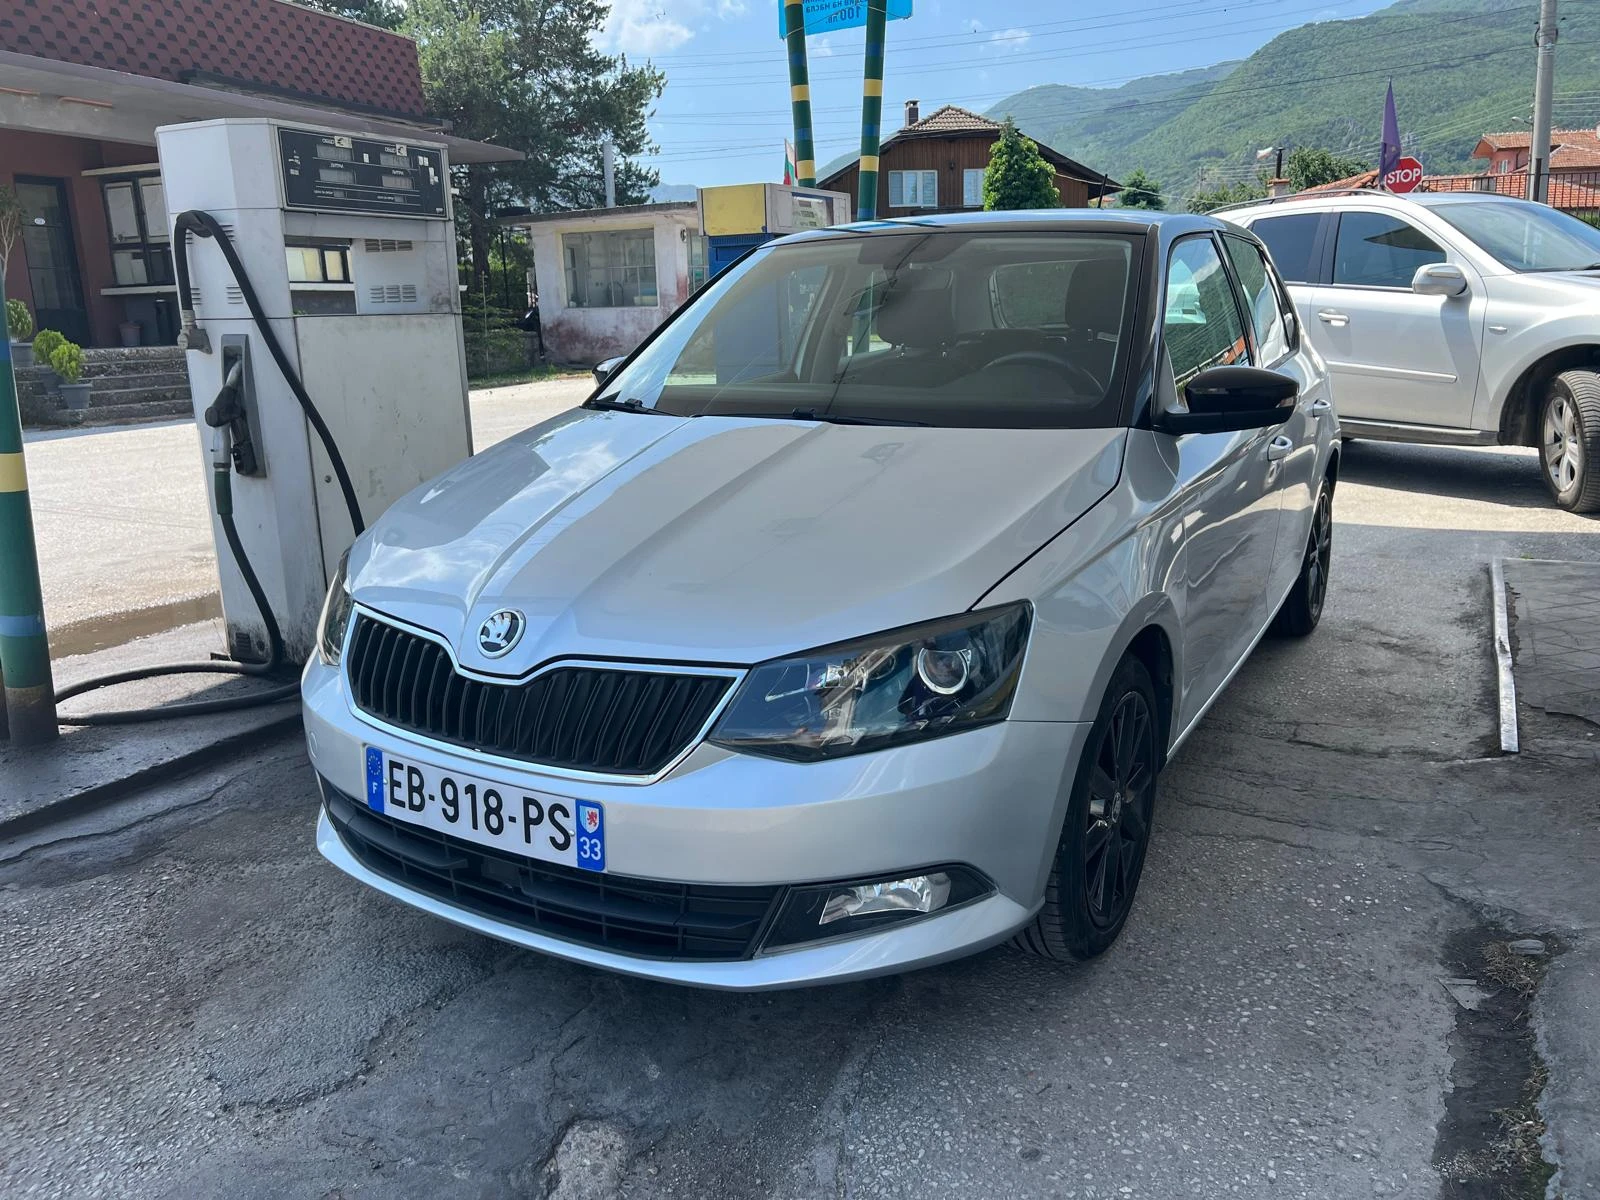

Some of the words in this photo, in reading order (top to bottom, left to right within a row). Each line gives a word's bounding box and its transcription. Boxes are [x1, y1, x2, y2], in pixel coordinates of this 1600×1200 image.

[1387, 168, 1421, 184] STOP
[372, 782, 378, 794] F
[388, 759, 571, 851] EB-918-PS
[579, 837, 602, 861] 33
